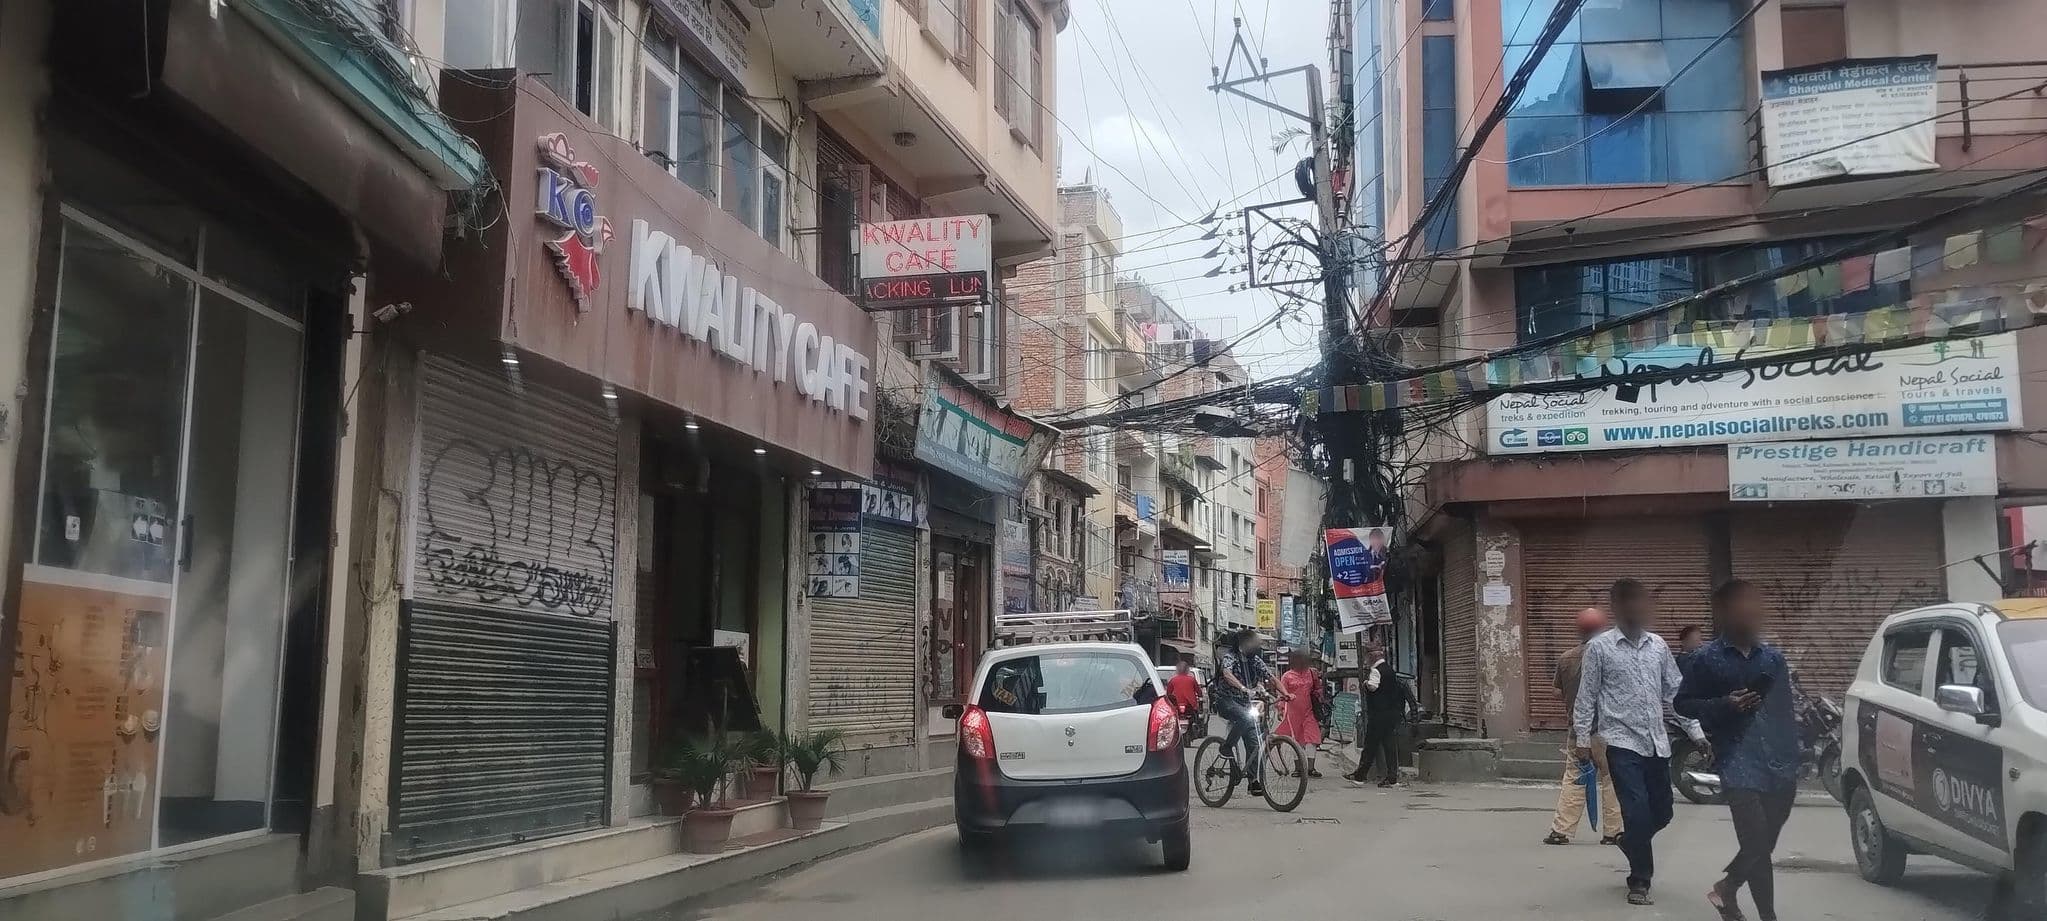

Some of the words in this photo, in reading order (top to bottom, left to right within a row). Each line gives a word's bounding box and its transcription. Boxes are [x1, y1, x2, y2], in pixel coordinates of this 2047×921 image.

[1788, 69, 1832, 84] भगवती
[1788, 82, 1841, 96] Bhagwati
[1845, 76, 1889, 90] Medical
[1893, 73, 1931, 84] Center
[863, 218, 983, 246] KWALITY
[628, 218, 796, 384] KWALITY
[795, 322, 870, 422] CAFE
[1900, 370, 1946, 390] Nepal
[1950, 366, 2005, 386] Social
[1500, 396, 1540, 414] Nepal
[1543, 392, 1588, 410] Social
[1942, 388, 1950, 397] &
[1956, 386, 2003, 396] travels
[1602, 405, 1642, 416] trekking,
[1645, 404, 1678, 414] touring
[1680, 403, 1698, 411] and
[1701, 400, 1749, 410] adventure
[1751, 398, 1772, 407] with
[1784, 395, 1814, 405] social
[1816, 392, 1874, 402] conscience
[1501, 414, 1524, 423] treks
[1527, 413, 1534, 421] &
[1536, 411, 1586, 422] expedition
[1603, 411, 1889, 442] www.nepalsocialtreks.com
[1736, 443, 1838, 461] Prestige
[1847, 437, 1987, 457] Handicraft
[1333, 546, 1363, 556] ADMISSION
[1335, 555, 1355, 567] OPEN
[1336, 571, 1349, 580] +2
[1951, 775, 1997, 821] DIVYA
